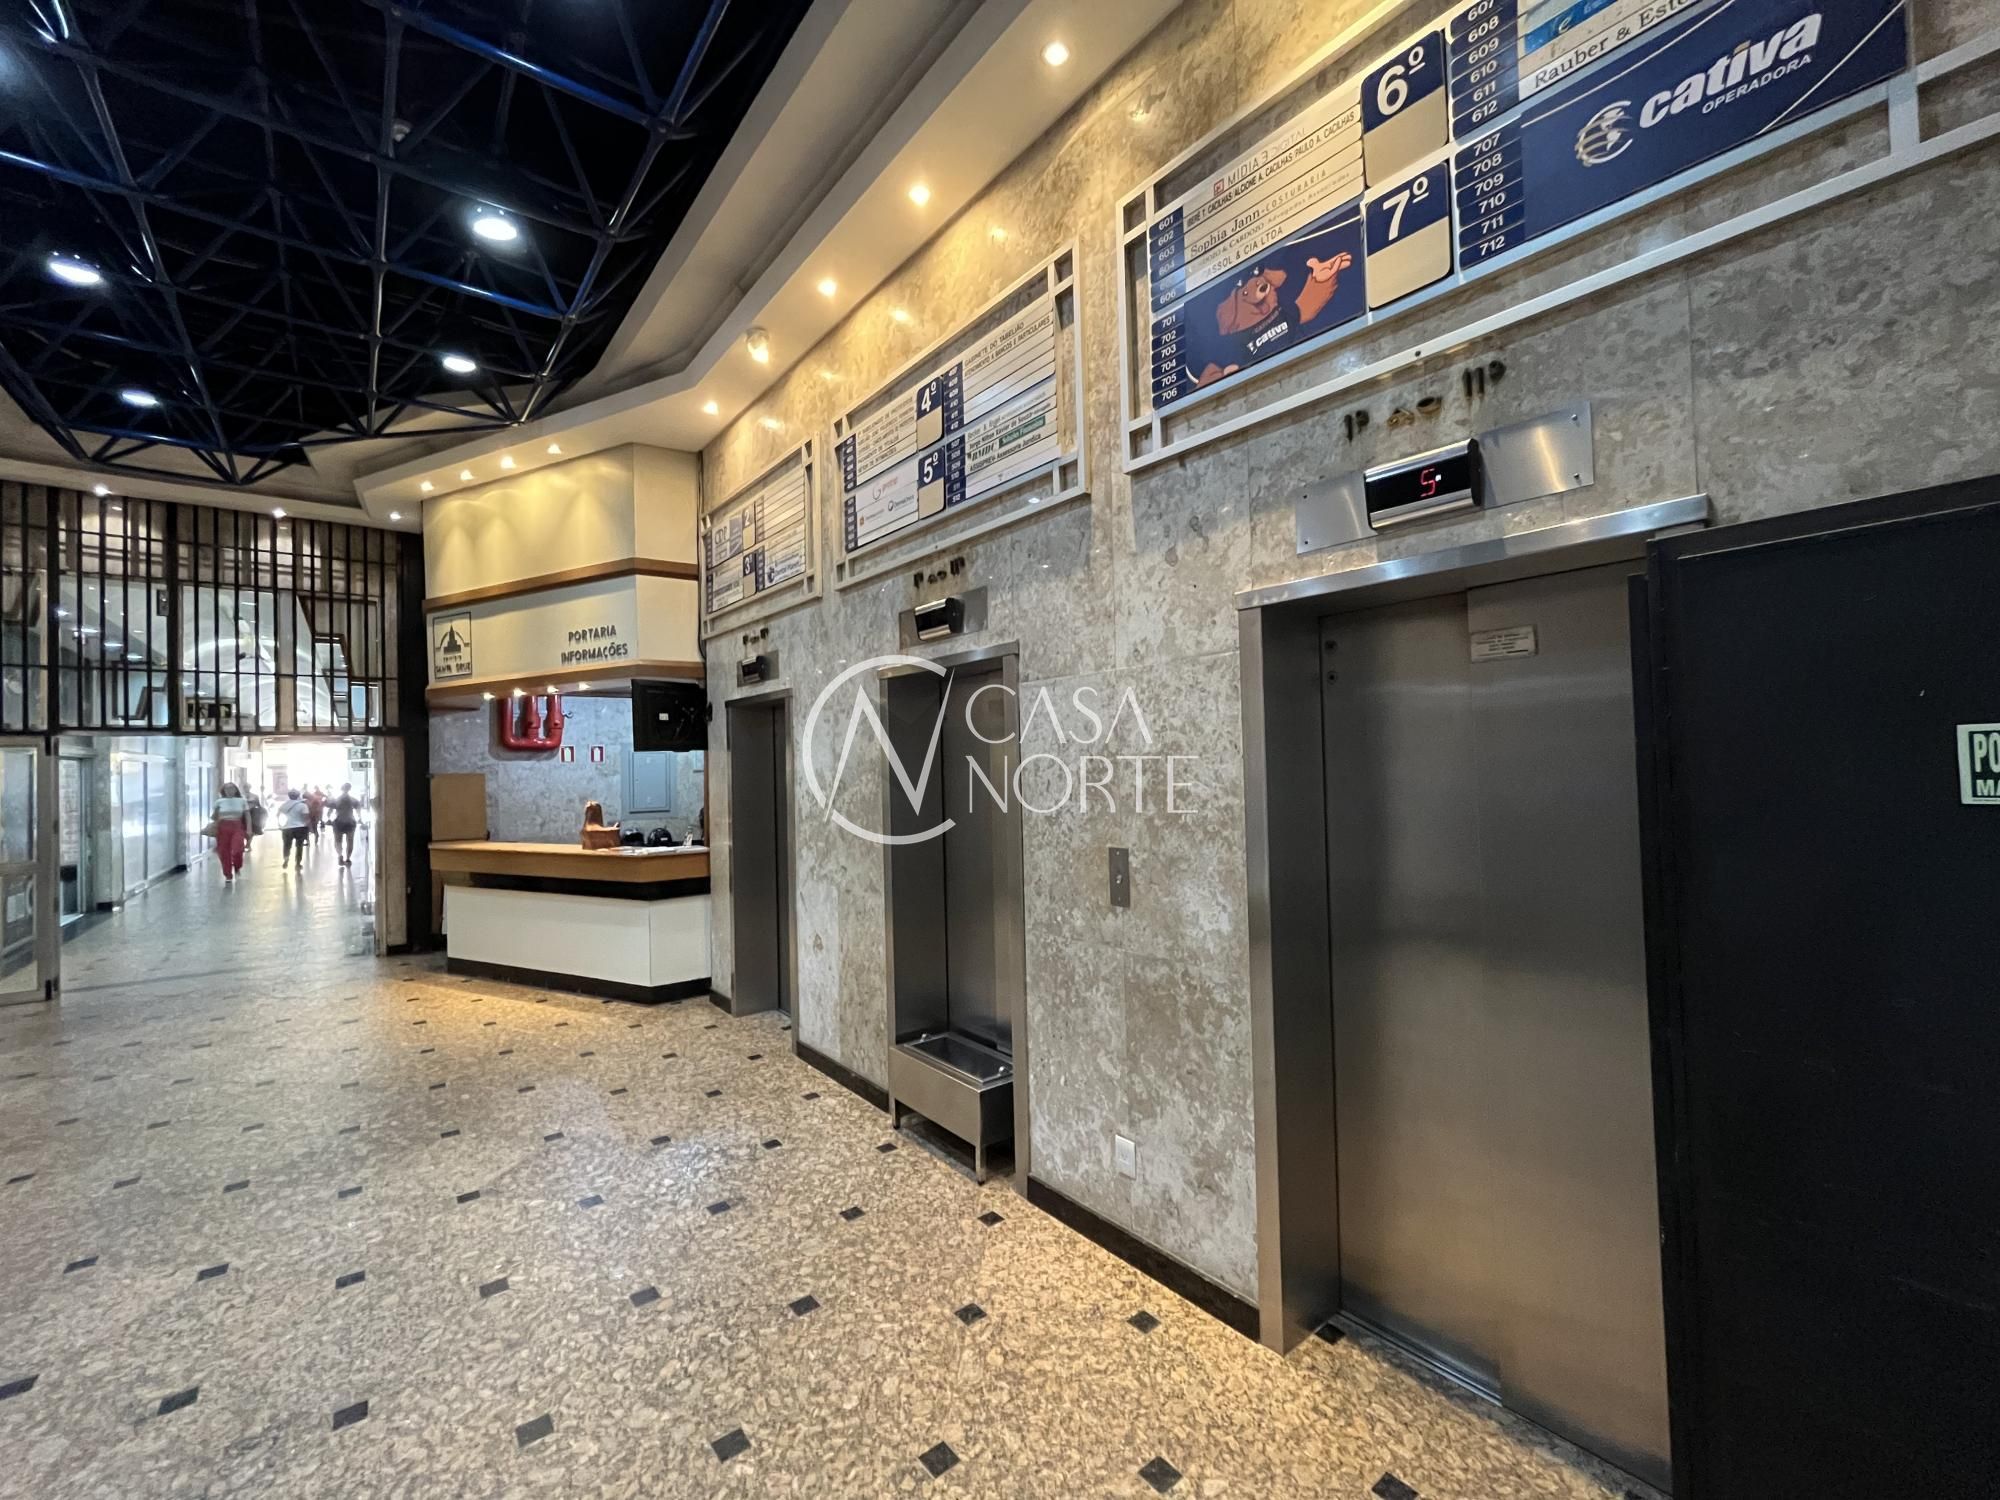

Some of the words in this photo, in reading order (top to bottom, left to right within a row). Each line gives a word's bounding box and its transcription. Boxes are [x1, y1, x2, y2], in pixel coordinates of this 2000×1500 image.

[1468, 15, 1499, 43] 608
[1468, 38, 1499, 64] 609
[1534, 37, 1608, 89] Rauber
[1615, 26, 1631, 41] &
[1377, 45, 1426, 116] 6º
[1470, 60, 1497, 83] 610
[1640, 13, 1822, 129] cativa
[1473, 81, 1496, 101] 611
[1702, 54, 1812, 114] OPERADORA
[1472, 100, 1498, 123] 612
[1323, 111, 1355, 138] CACILHAS
[1474, 132, 1501, 156] 707
[1473, 153, 1502, 177] 708
[1475, 173, 1504, 196] 709
[1383, 176, 1429, 240] 7º
[1479, 192, 1506, 214] 710
[1159, 215, 1174, 231] 601
[1191, 229, 1227, 257] Sophia
[1231, 209, 1259, 232] Jann
[1481, 215, 1504, 235] 711
[1158, 230, 1174, 246] 602
[1244, 240, 1258, 255] CIA
[1261, 226, 1283, 246] LTDA
[1480, 235, 1505, 256] 712
[1159, 245, 1175, 261] 603
[1160, 288, 1176, 304] 606
[1162, 314, 1176, 328] 701
[1161, 330, 1176, 345] 702
[1256, 321, 1288, 347] cativa
[1161, 344, 1176, 358] 703
[1161, 359, 1176, 373] 704
[1161, 373, 1177, 387] 705
[921, 382, 937, 412] 4º
[1162, 388, 1177, 401] 706
[923, 452, 939, 484] 5º
[568, 625, 616, 643] PORTARIA
[561, 642, 628, 664] INFORMAÇÕES
